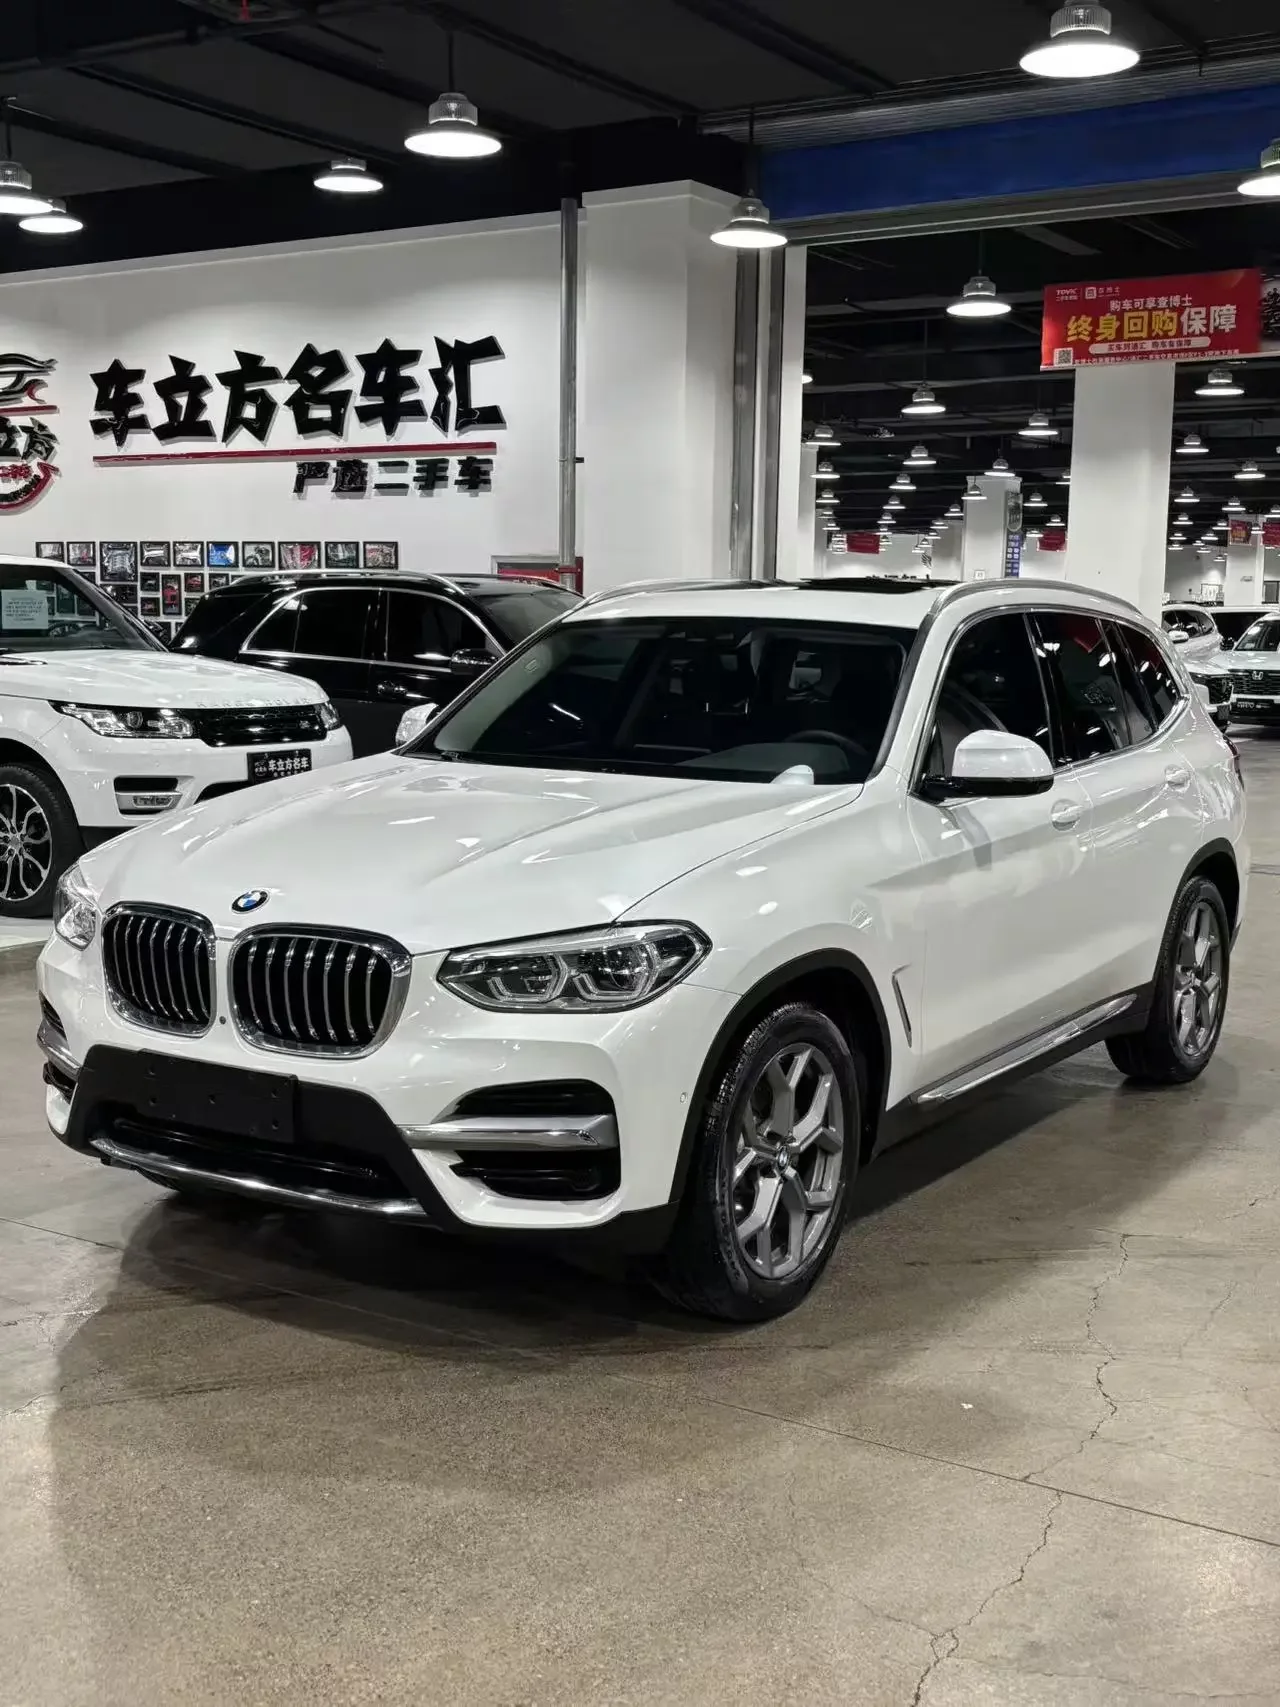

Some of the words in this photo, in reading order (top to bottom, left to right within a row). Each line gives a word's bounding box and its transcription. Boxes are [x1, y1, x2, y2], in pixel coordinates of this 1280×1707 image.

[1066, 304, 1237, 343] 终身回购保障
[89, 336, 505, 448] 车立方名车汇
[268, 757, 309, 771] 车立方名车
